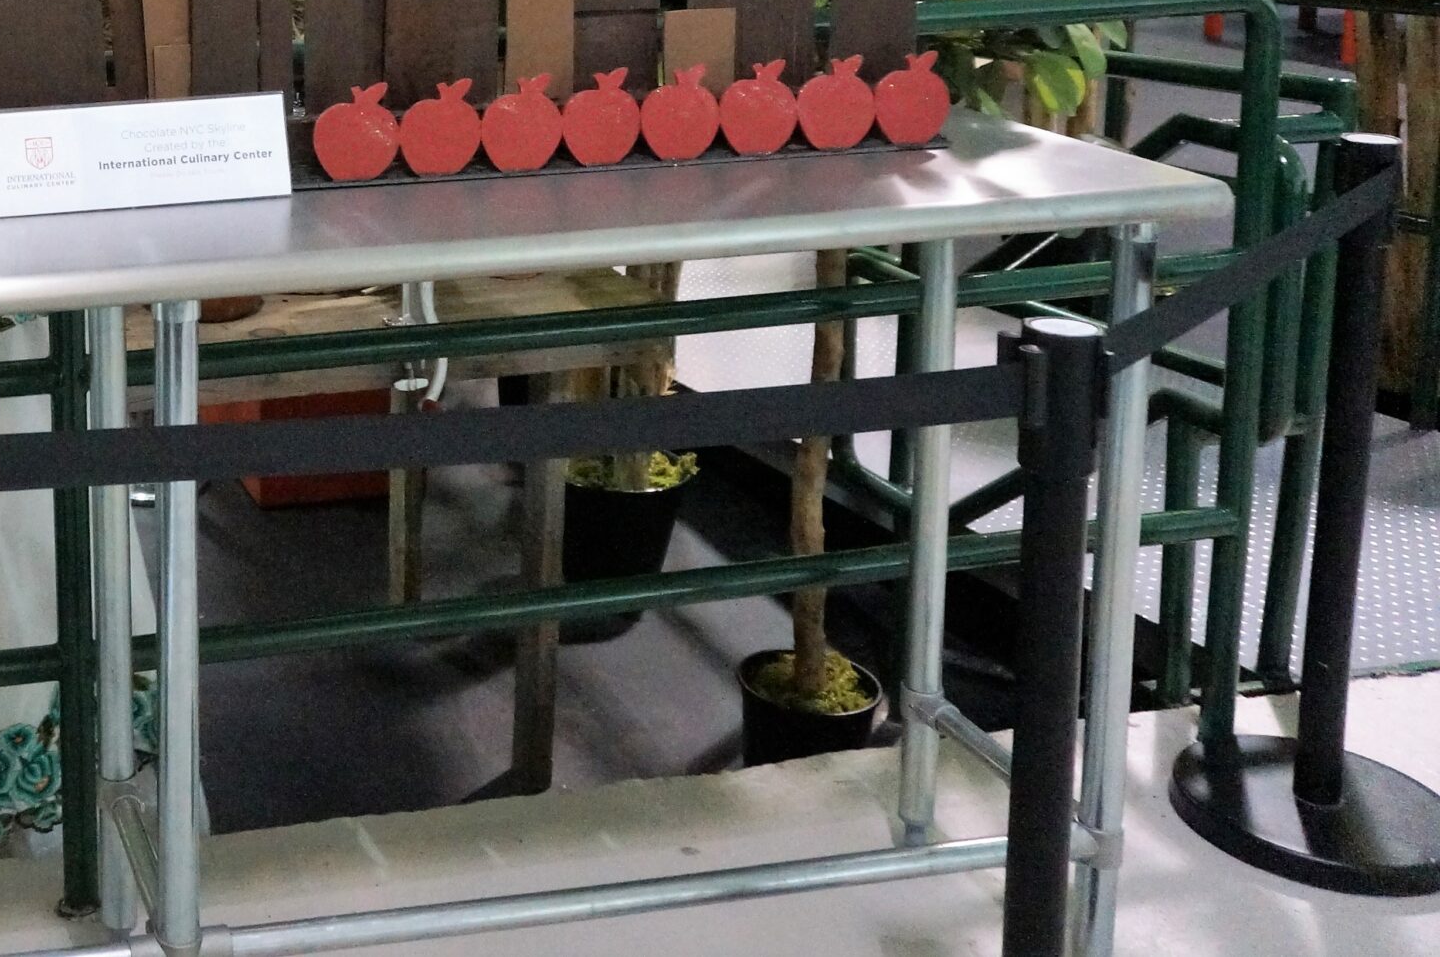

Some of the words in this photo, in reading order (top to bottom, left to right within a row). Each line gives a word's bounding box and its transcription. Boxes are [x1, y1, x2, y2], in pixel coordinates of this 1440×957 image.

[120, 127, 177, 140] Chocolate
[180, 124, 204, 136] NYC
[207, 122, 246, 135] Skyline
[144, 140, 188, 153] Created
[191, 140, 205, 151] by
[208, 138, 226, 148] the
[98, 155, 177, 171] International
[180, 153, 230, 164] Culinary
[233, 149, 273, 160] Center
[6, 171, 76, 184] INTERNATIONAL
